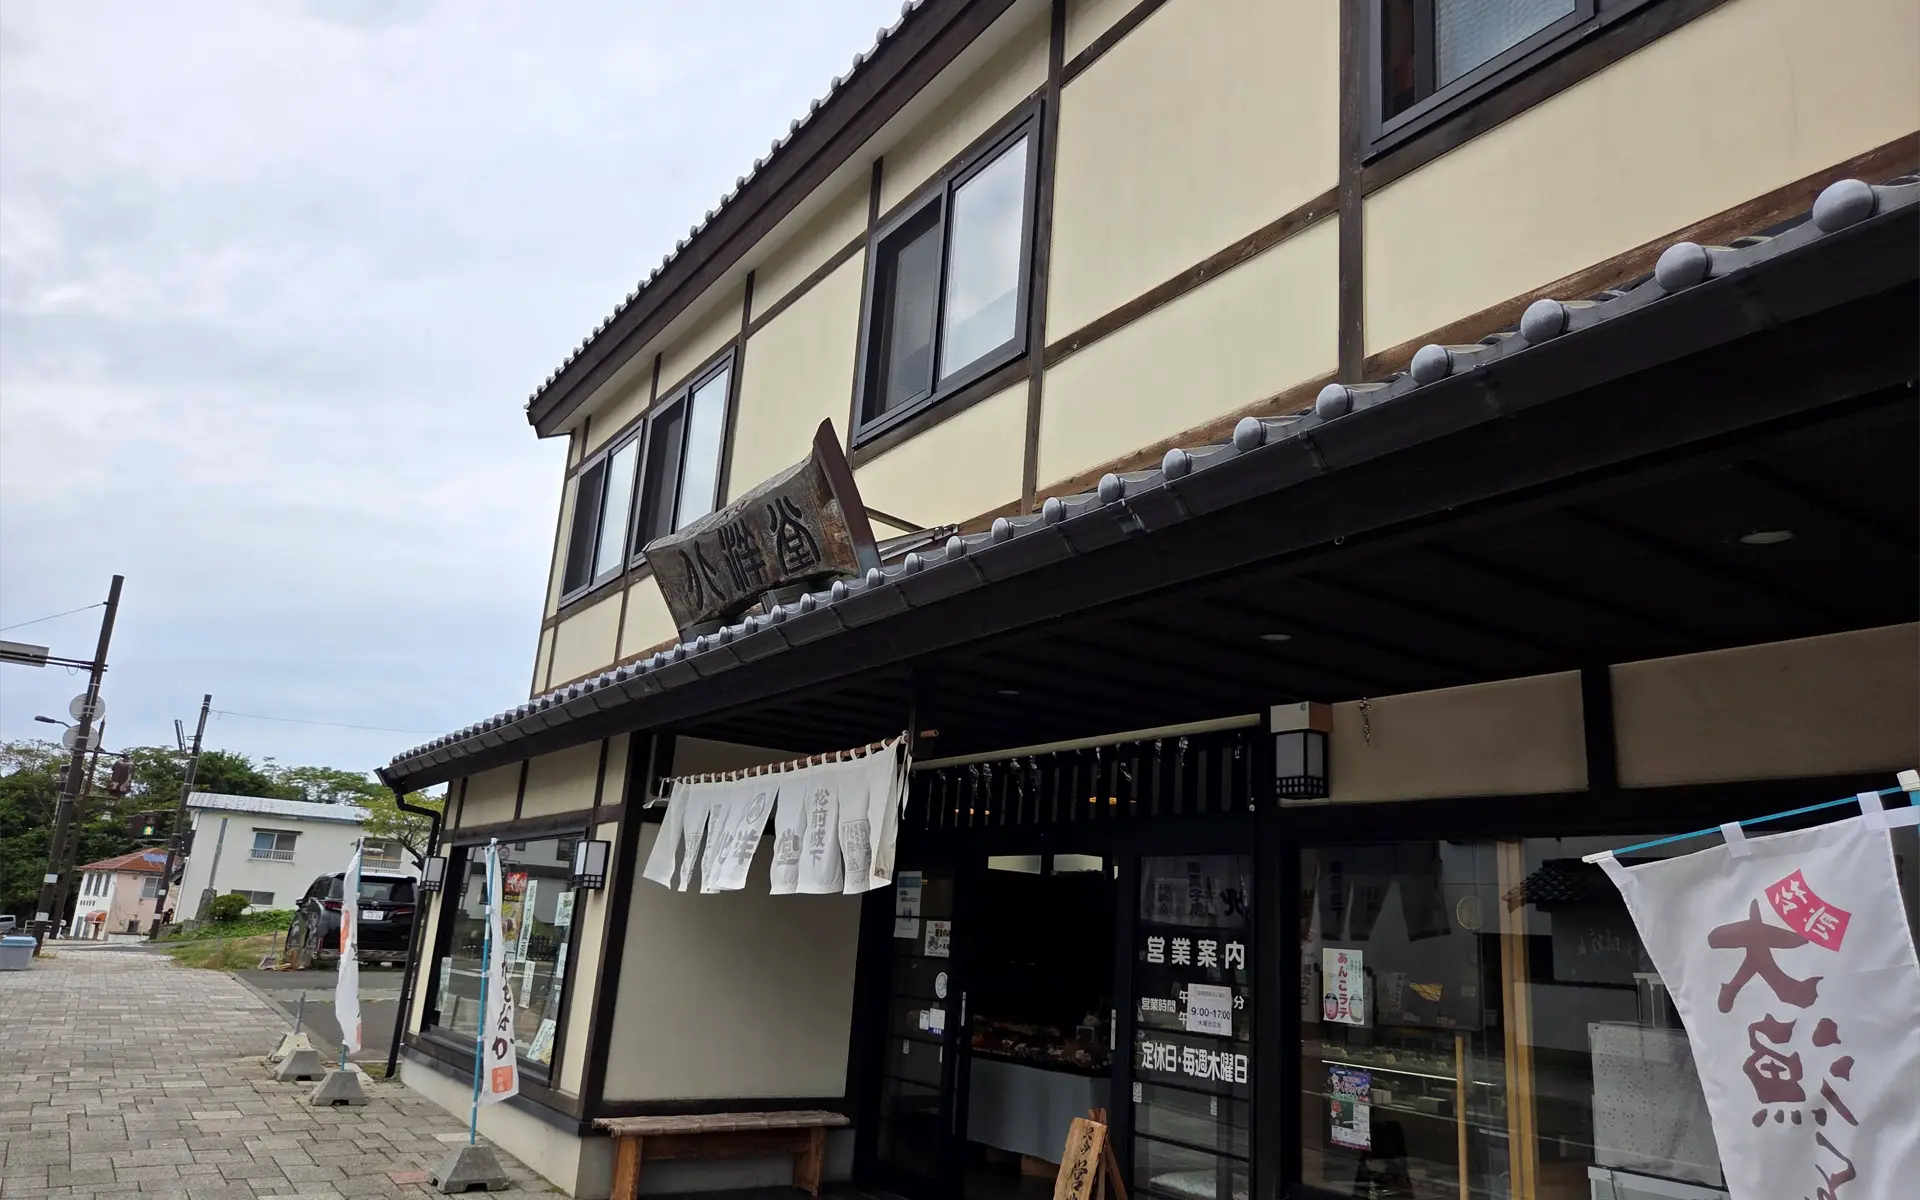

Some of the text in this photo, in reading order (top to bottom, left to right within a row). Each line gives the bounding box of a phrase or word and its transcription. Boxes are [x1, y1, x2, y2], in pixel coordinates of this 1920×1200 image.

[809, 788, 831, 868] 松前城下
[1147, 936, 1245, 970] 営業案内
[1141, 997, 1177, 1013] 営業時間
[1233, 995, 1245, 1010] 分
